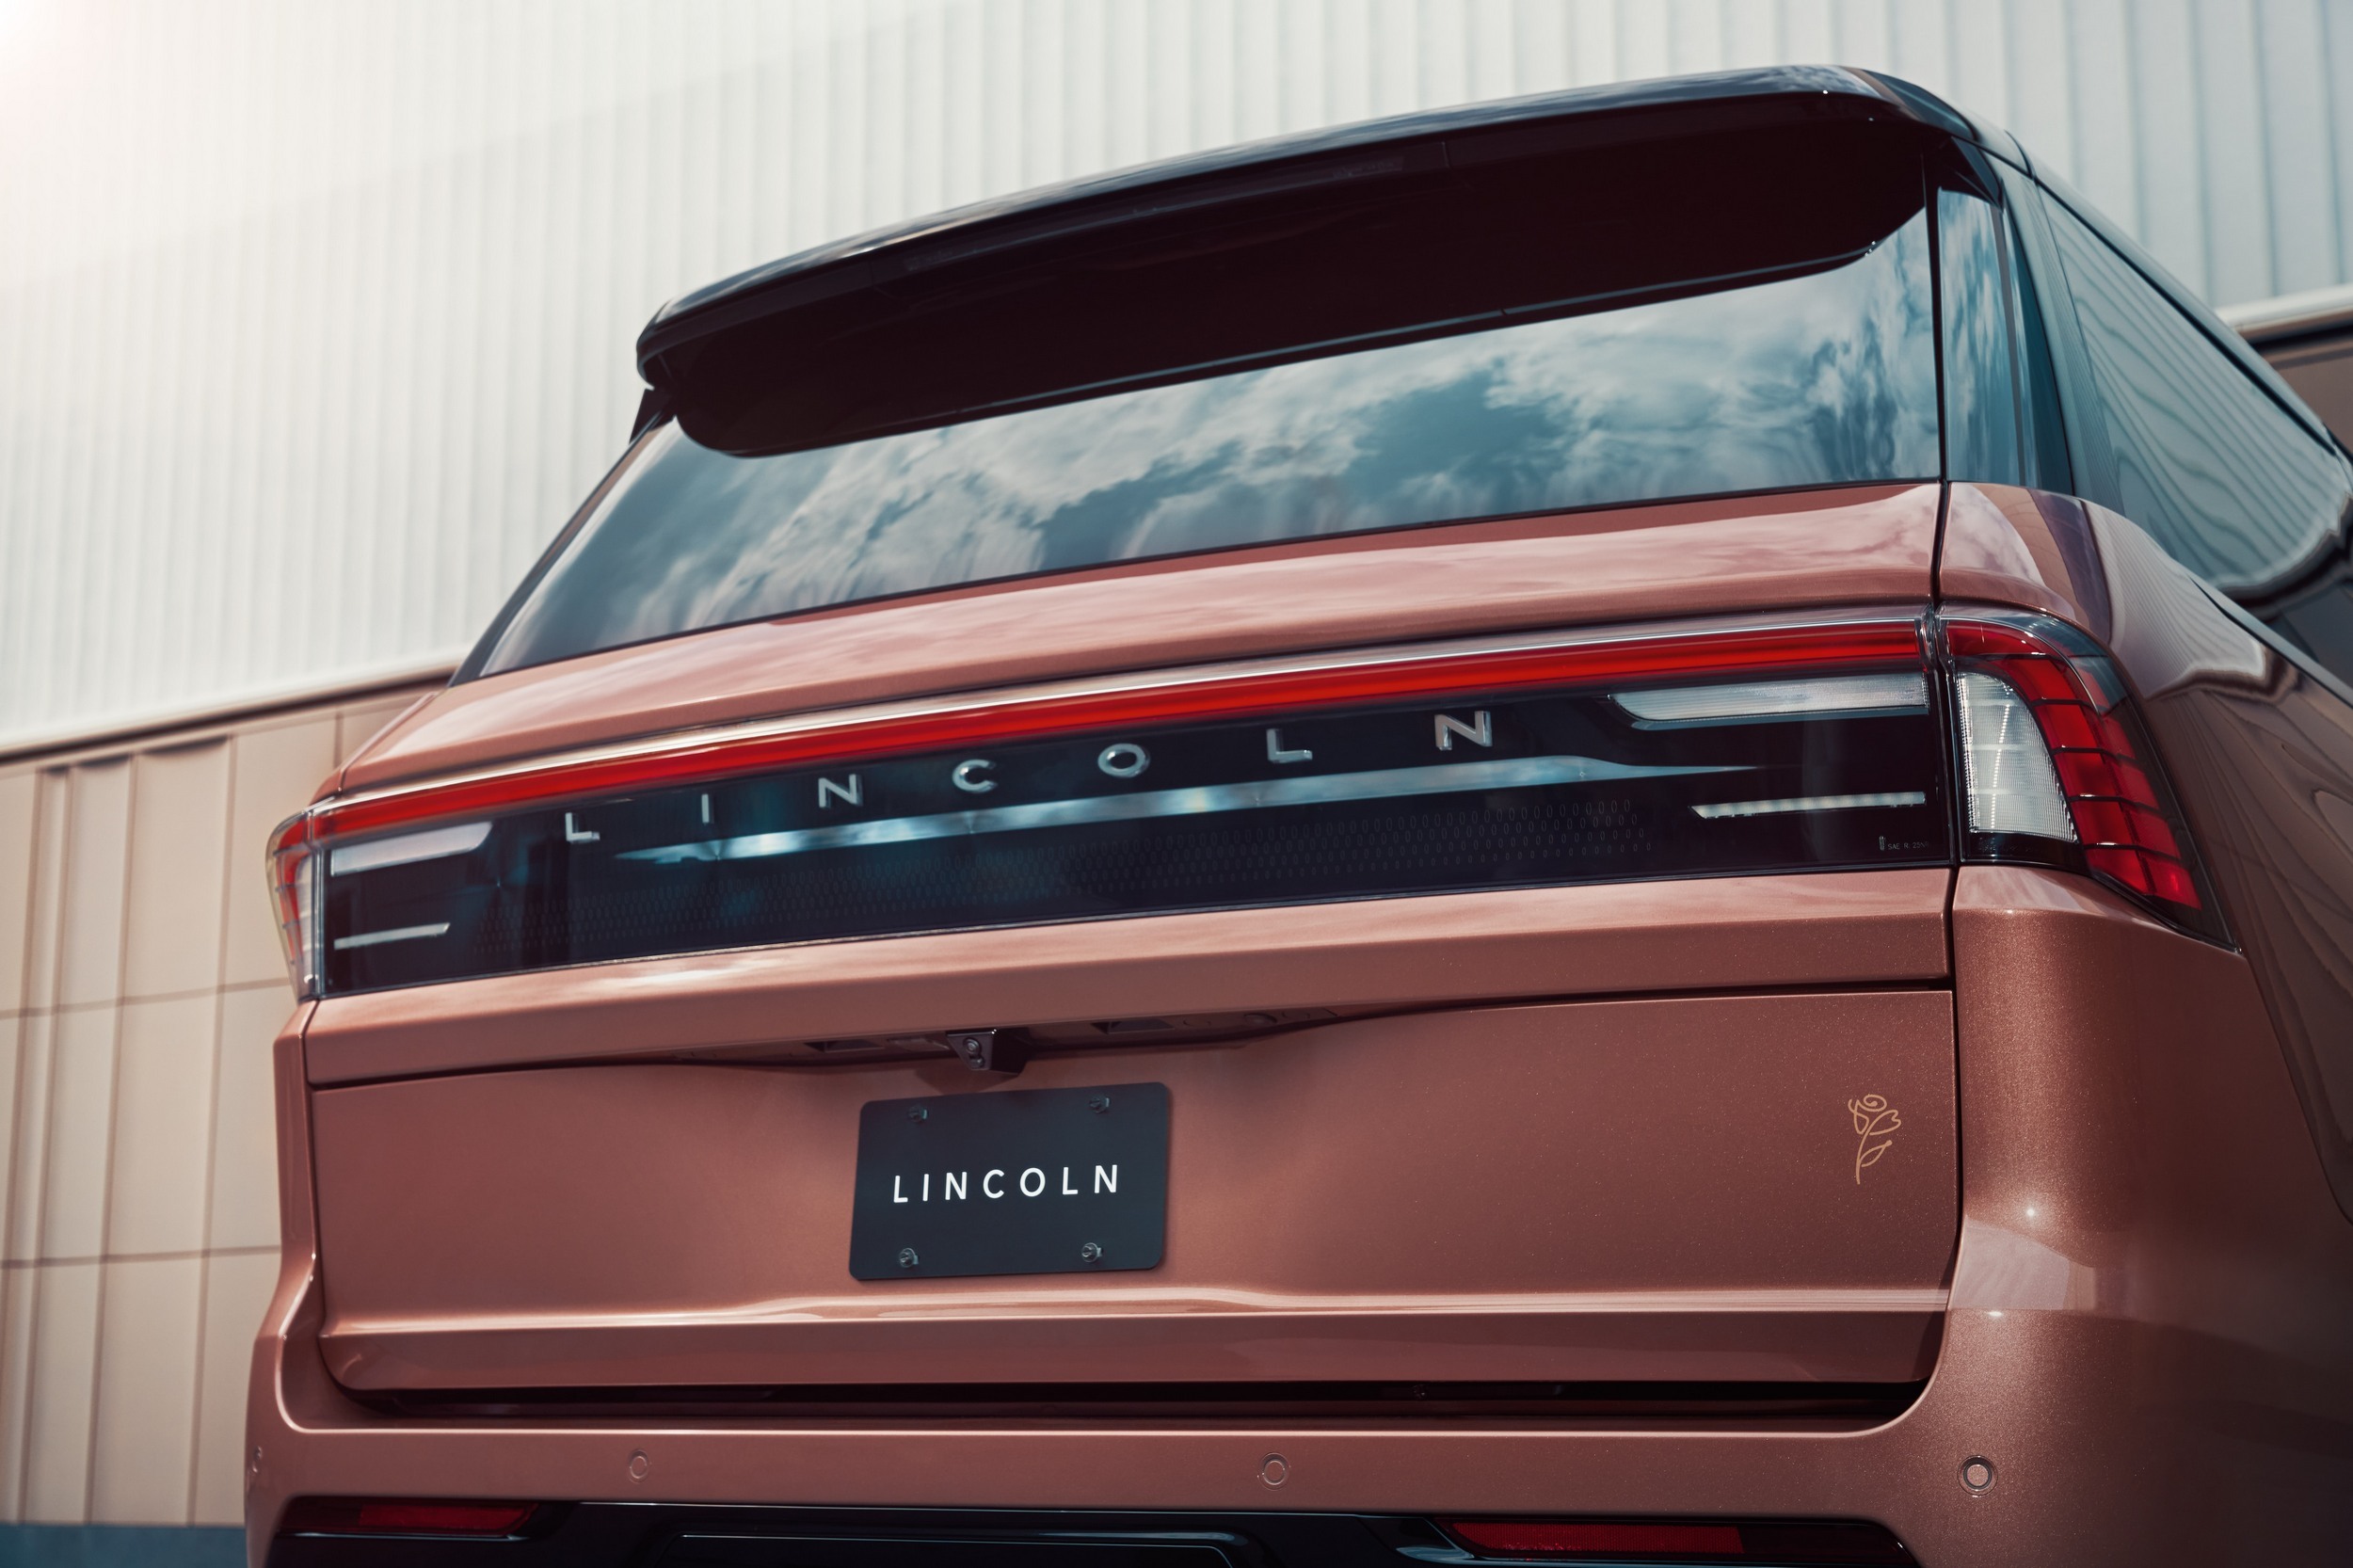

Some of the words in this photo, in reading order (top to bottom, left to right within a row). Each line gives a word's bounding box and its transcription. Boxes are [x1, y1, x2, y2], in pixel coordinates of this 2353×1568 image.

[565, 710, 1493, 844] LINCOLN
[1887, 842, 1900, 851] SAE
[893, 1164, 1118, 1203] LINCOLN
